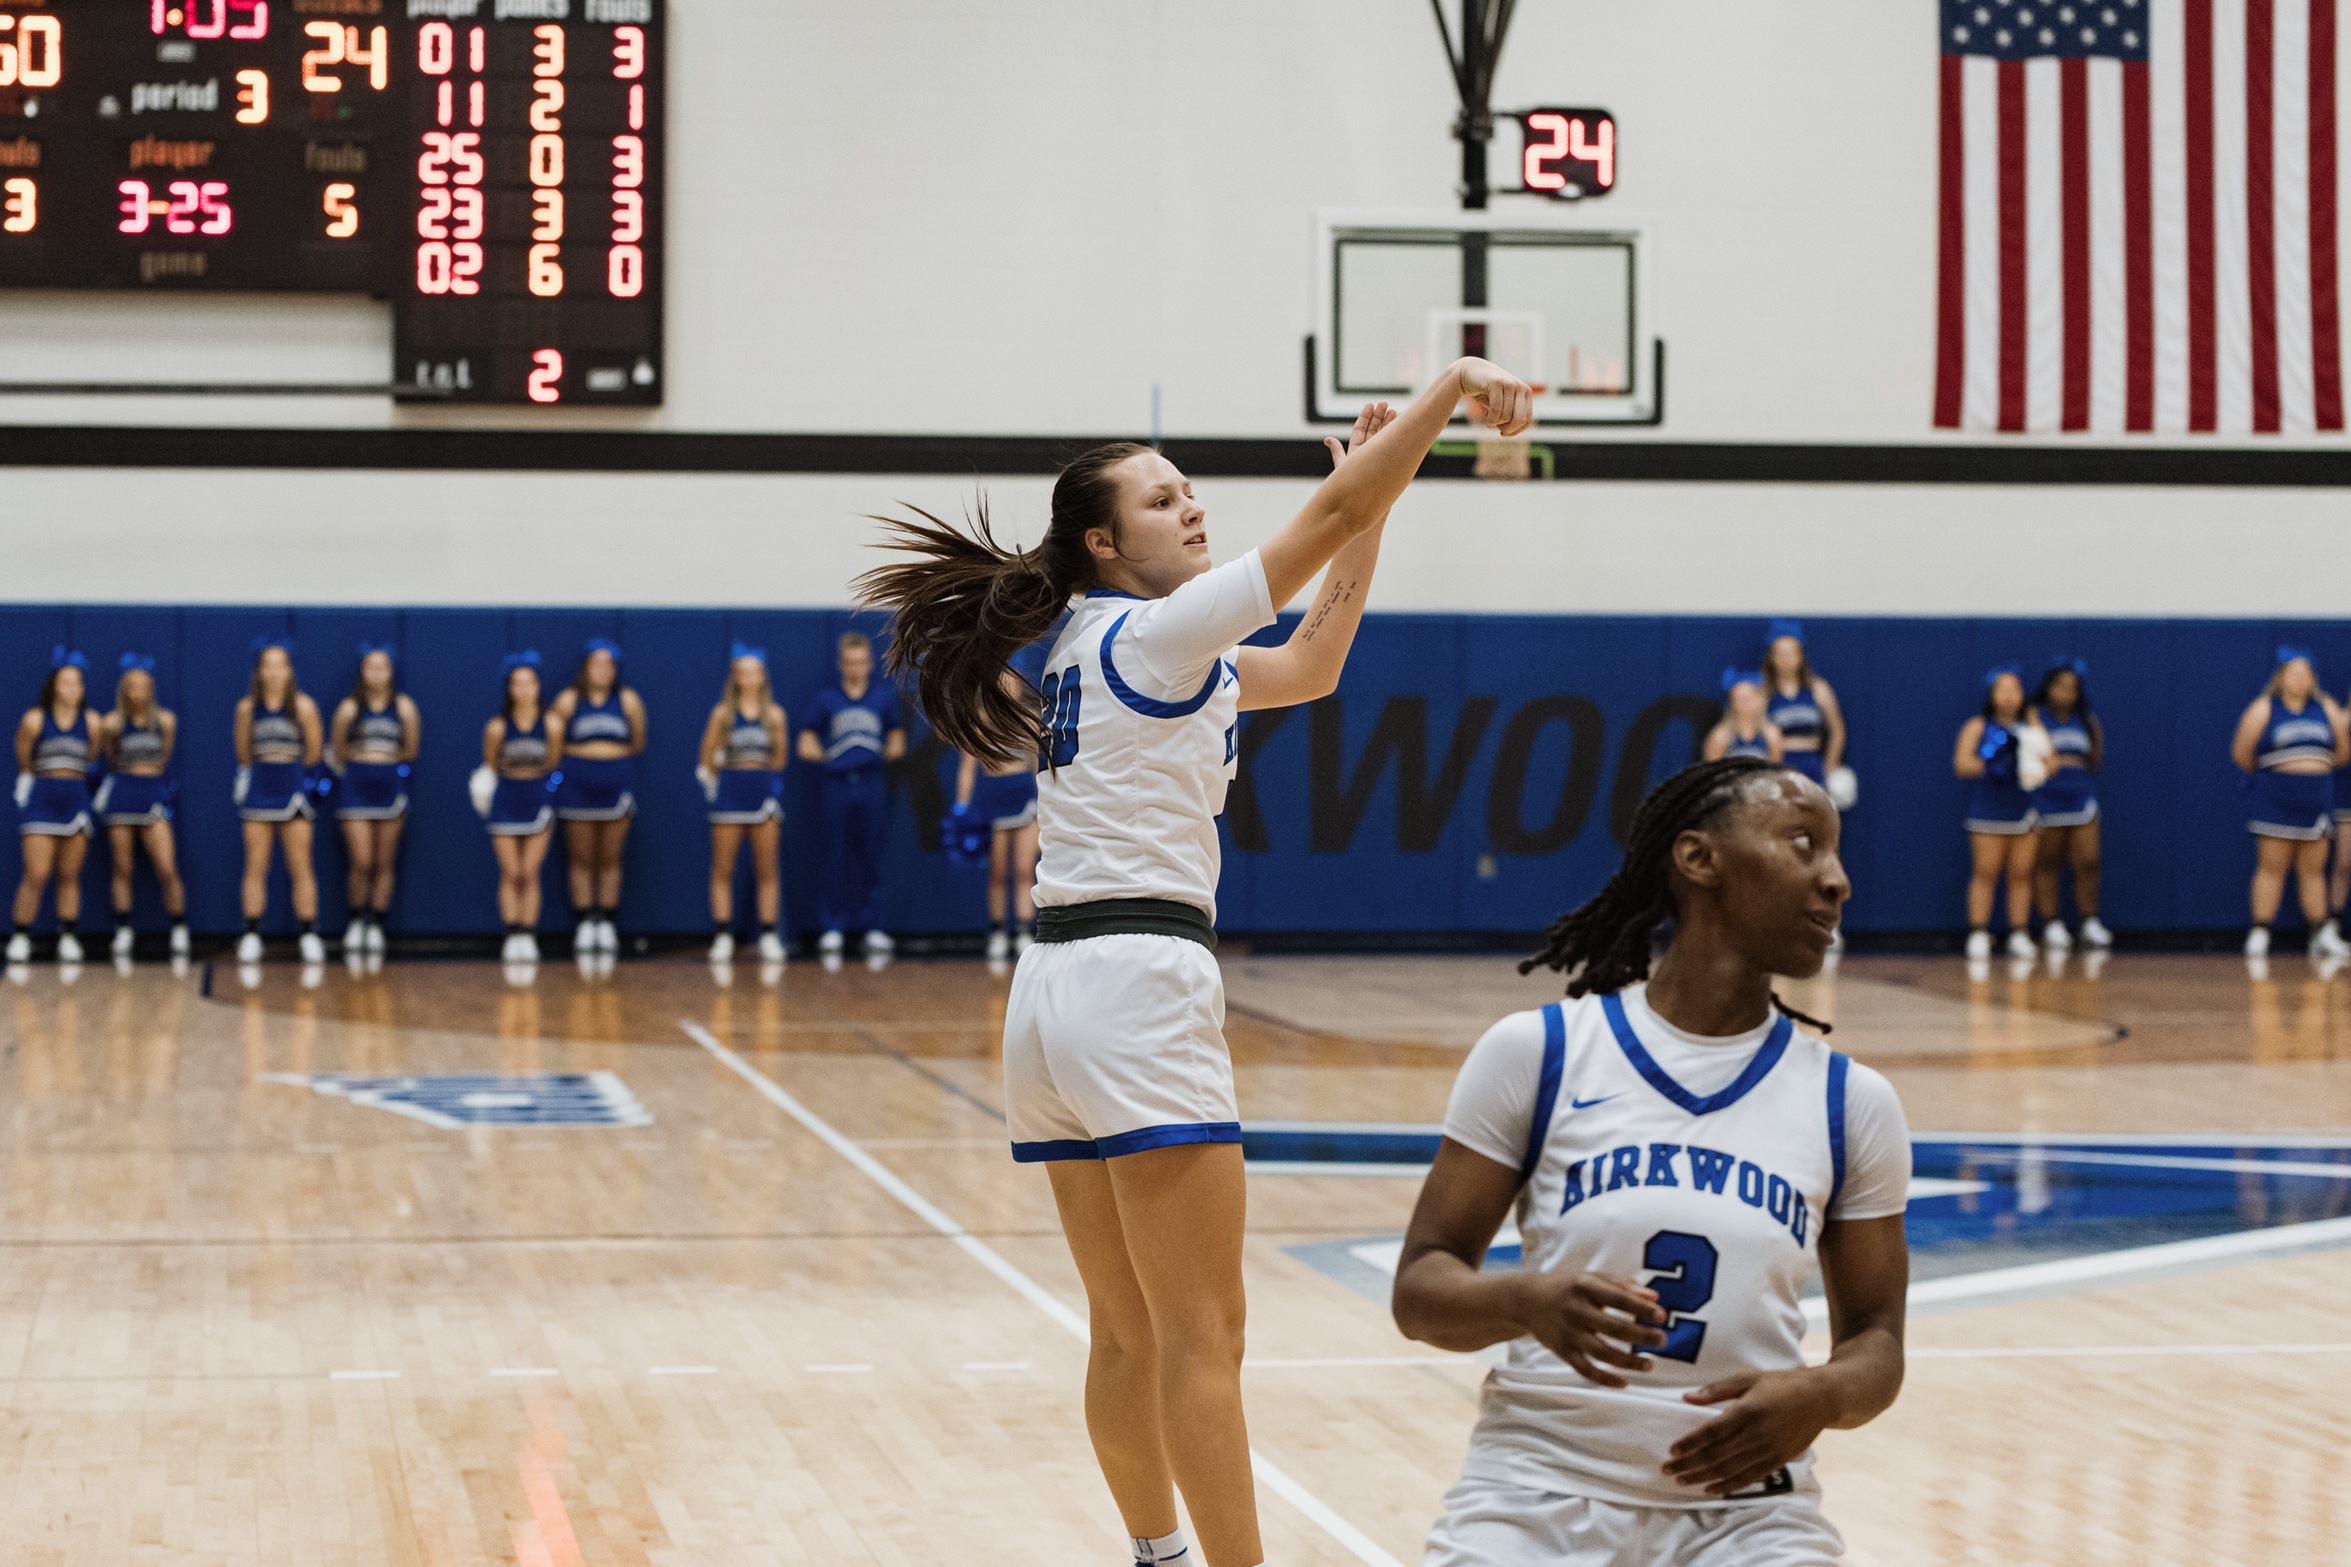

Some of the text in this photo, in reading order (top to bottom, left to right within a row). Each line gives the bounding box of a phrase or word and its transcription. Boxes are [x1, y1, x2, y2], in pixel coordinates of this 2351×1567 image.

[302, 21, 388, 92] 24
[418, 22, 645, 79] 01 3 3
[235, 69, 269, 124] 3
[437, 79, 644, 132] 11 2 1
[418, 132, 644, 188] 25 0 3
[1524, 113, 1614, 189] 24
[3, 178, 37, 233] 3
[118, 180, 233, 235] 3-25
[323, 183, 359, 238] 5
[417, 187, 644, 243] 23 3 3
[417, 241, 643, 297] 02 6 0
[528, 348, 563, 403] 2
[1560, 1143, 1808, 1249] KIRKWOOD
[1632, 1229, 1719, 1364] 2
